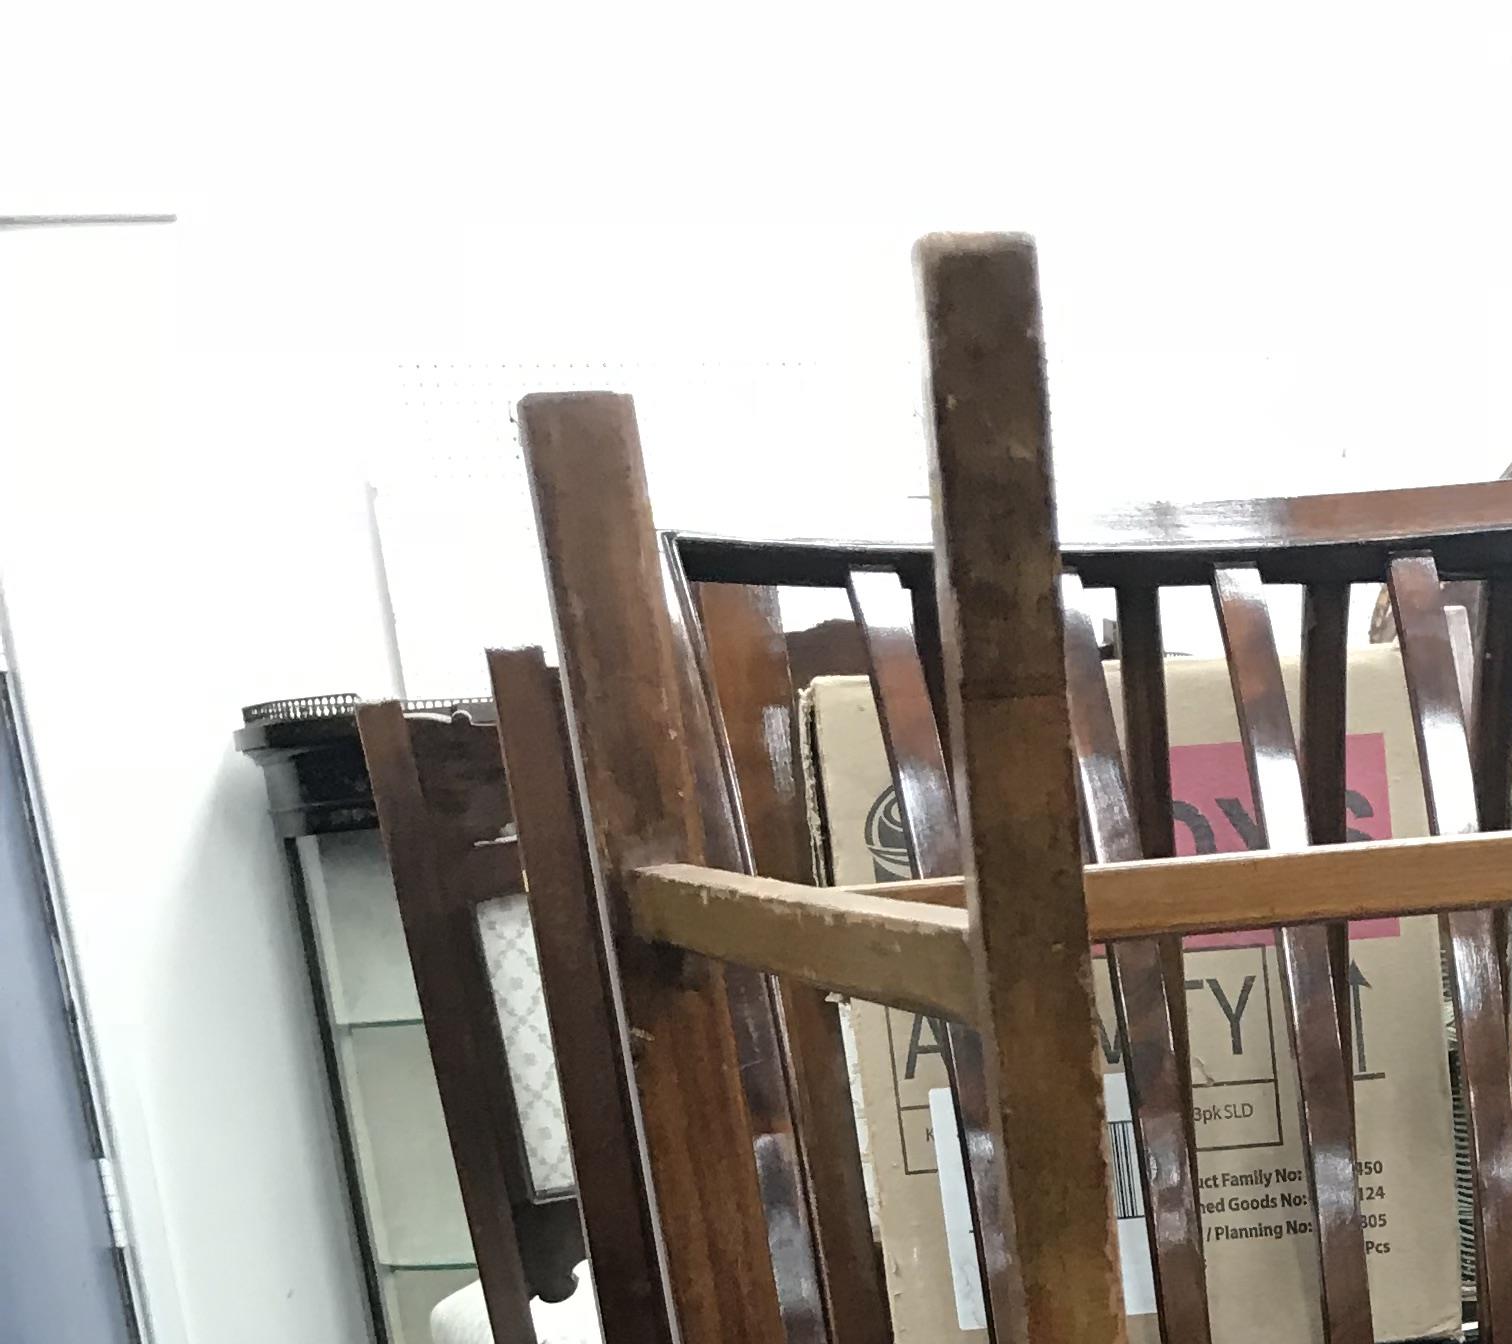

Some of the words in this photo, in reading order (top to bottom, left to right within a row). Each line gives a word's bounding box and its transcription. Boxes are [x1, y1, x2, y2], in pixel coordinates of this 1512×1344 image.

[1224, 1102, 1254, 1120] SLD
[1221, 1168, 1273, 1188] Family
[1274, 1168, 1303, 1184] No:
[1228, 1194, 1278, 1212] Goods
[1280, 1193, 1308, 1208] No:
[1214, 1222, 1283, 1241] Planning
[1285, 1220, 1313, 1235] No:
[1365, 1241, 1391, 1255] Pcs
